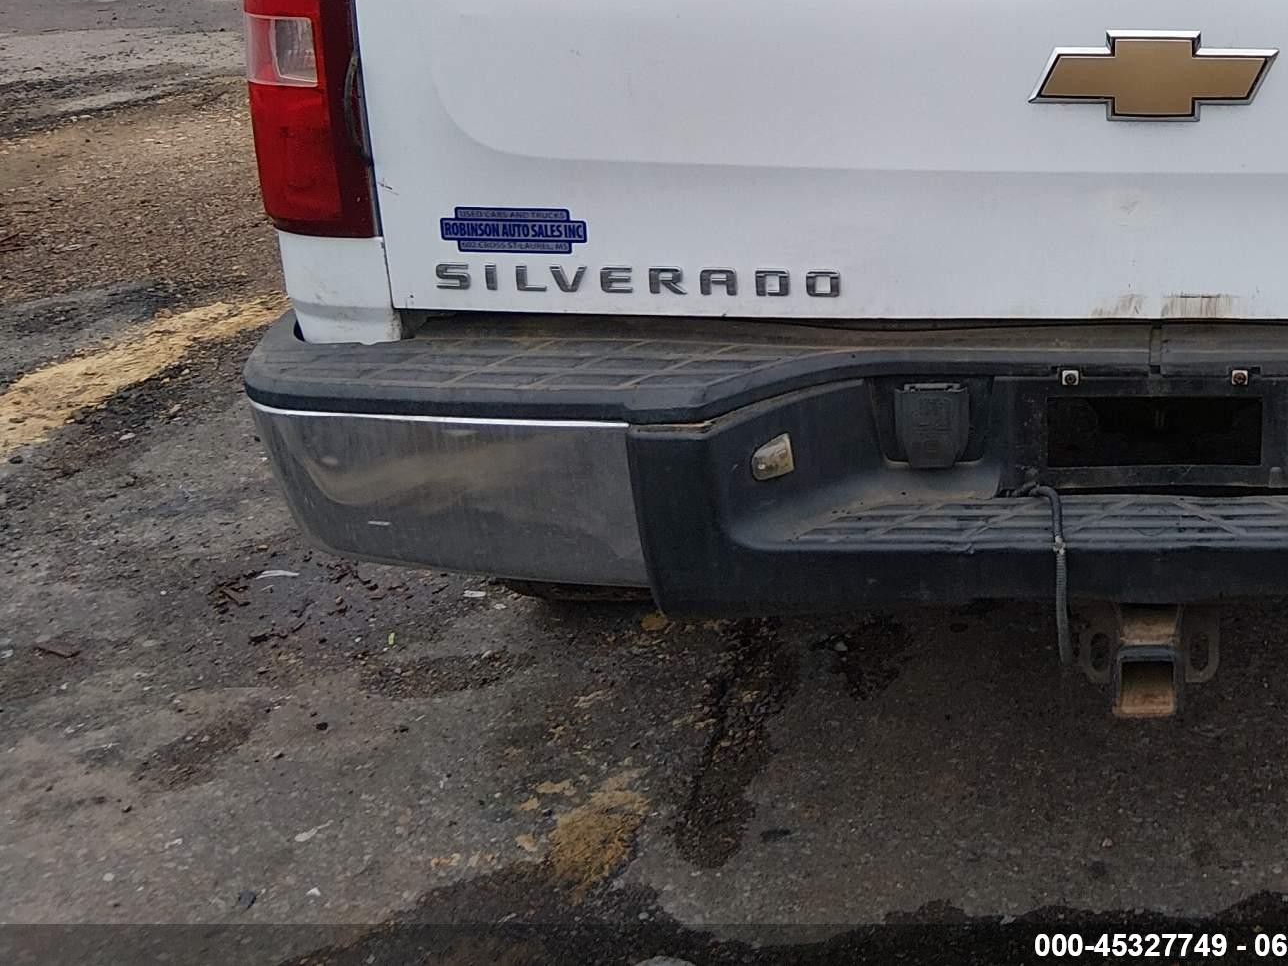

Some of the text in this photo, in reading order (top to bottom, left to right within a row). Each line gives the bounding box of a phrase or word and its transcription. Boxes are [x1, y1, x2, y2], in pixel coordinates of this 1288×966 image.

[444, 222, 583, 239] ROBINSON AUTO SALES INC
[435, 263, 841, 298] SILVERADO
